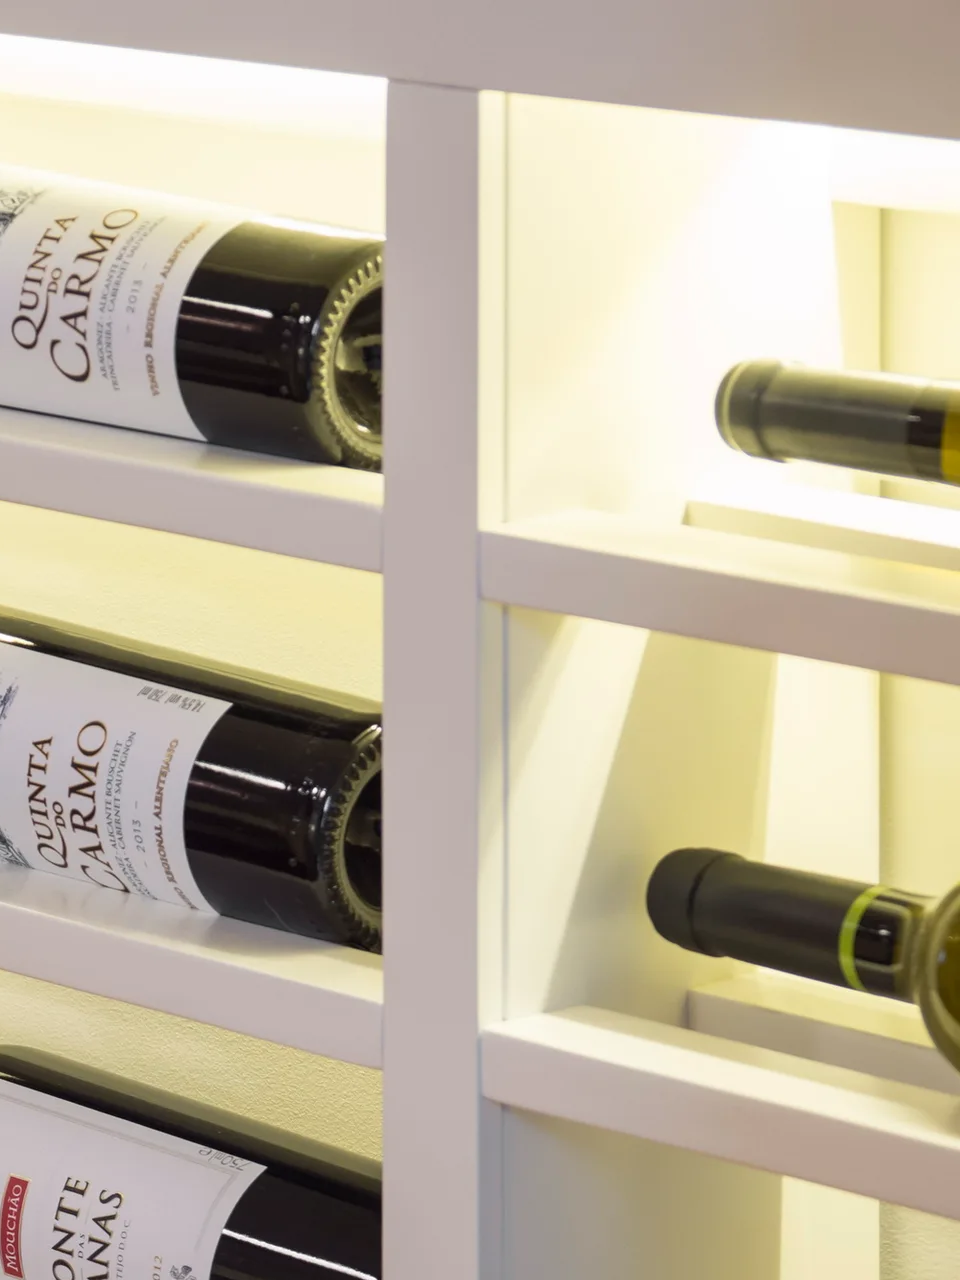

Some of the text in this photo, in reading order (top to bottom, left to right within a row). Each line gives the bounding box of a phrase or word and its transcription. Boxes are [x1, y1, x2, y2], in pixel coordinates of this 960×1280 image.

[11, 215, 79, 350] QUINTA
[47, 267, 63, 294] DO
[49, 208, 138, 383] CARMO
[99, 263, 119, 314] ALICANTE
[126, 280, 143, 314] 2013
[144, 282, 165, 349] REGIONAL
[95, 321, 108, 379] ARAGONEZ
[144, 353, 160, 397] VINHO
[105, 740, 123, 797] BOUSCHET
[113, 731, 137, 794] SAUVIGNON
[152, 738, 180, 821] ALENTEJANO
[26, 736, 68, 869] QUINTA
[52, 800, 67, 829] DO
[67, 720, 130, 894] CARMO
[103, 800, 118, 849] ALICANTE
[112, 796, 126, 850] CABERNET
[131, 819, 146, 853] 2013
[152, 824, 178, 884] REGIONAL
[6, 1184, 23, 1272] MOUCHÃO
[77, 1232, 86, 1259] DAS
